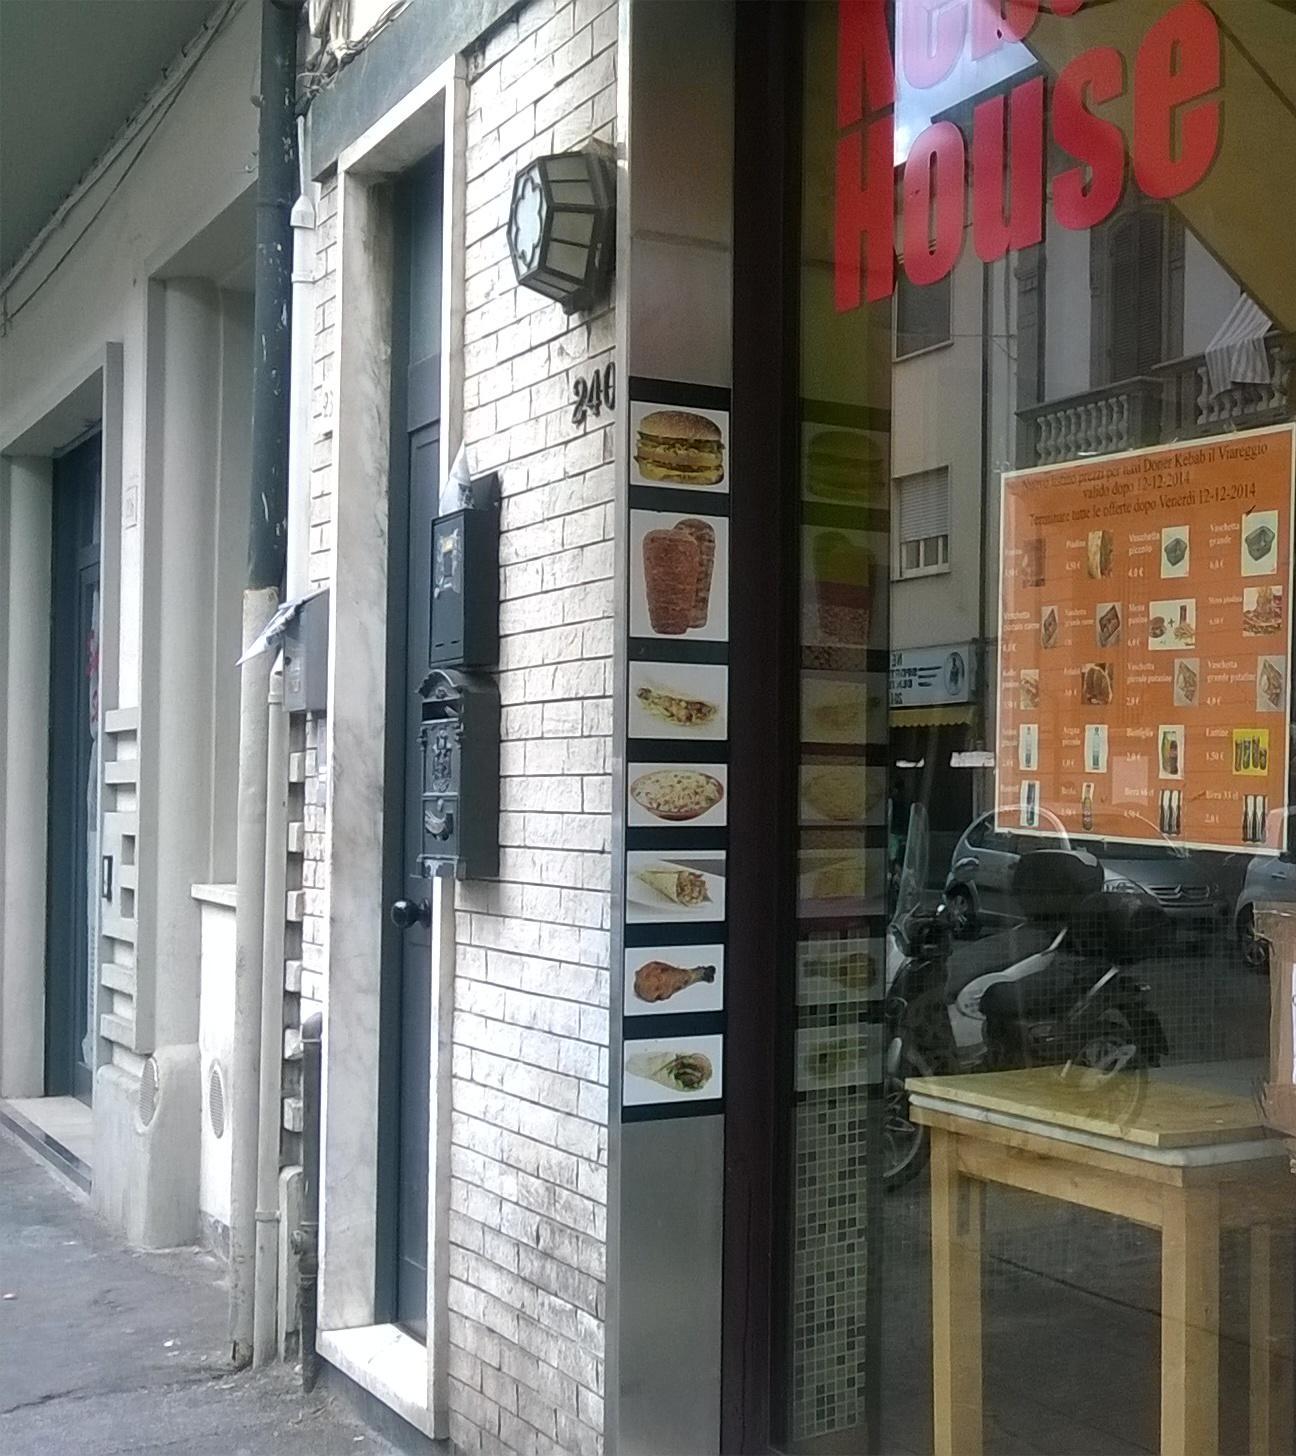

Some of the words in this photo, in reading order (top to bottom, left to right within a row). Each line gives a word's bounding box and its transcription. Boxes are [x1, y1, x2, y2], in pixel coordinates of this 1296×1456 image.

[834, 0, 1221, 313] House
[572, 361, 616, 428] 240
[1174, 450, 1206, 468] Kebab
[1218, 443, 1268, 461] Viareggio
[1103, 501, 1132, 517] offerte
[1133, 497, 1157, 515] dopo
[1199, 482, 1256, 505] 12-12-2014
[1111, 479, 1135, 498] dopo
[1137, 470, 1191, 492] 12-12-2014
